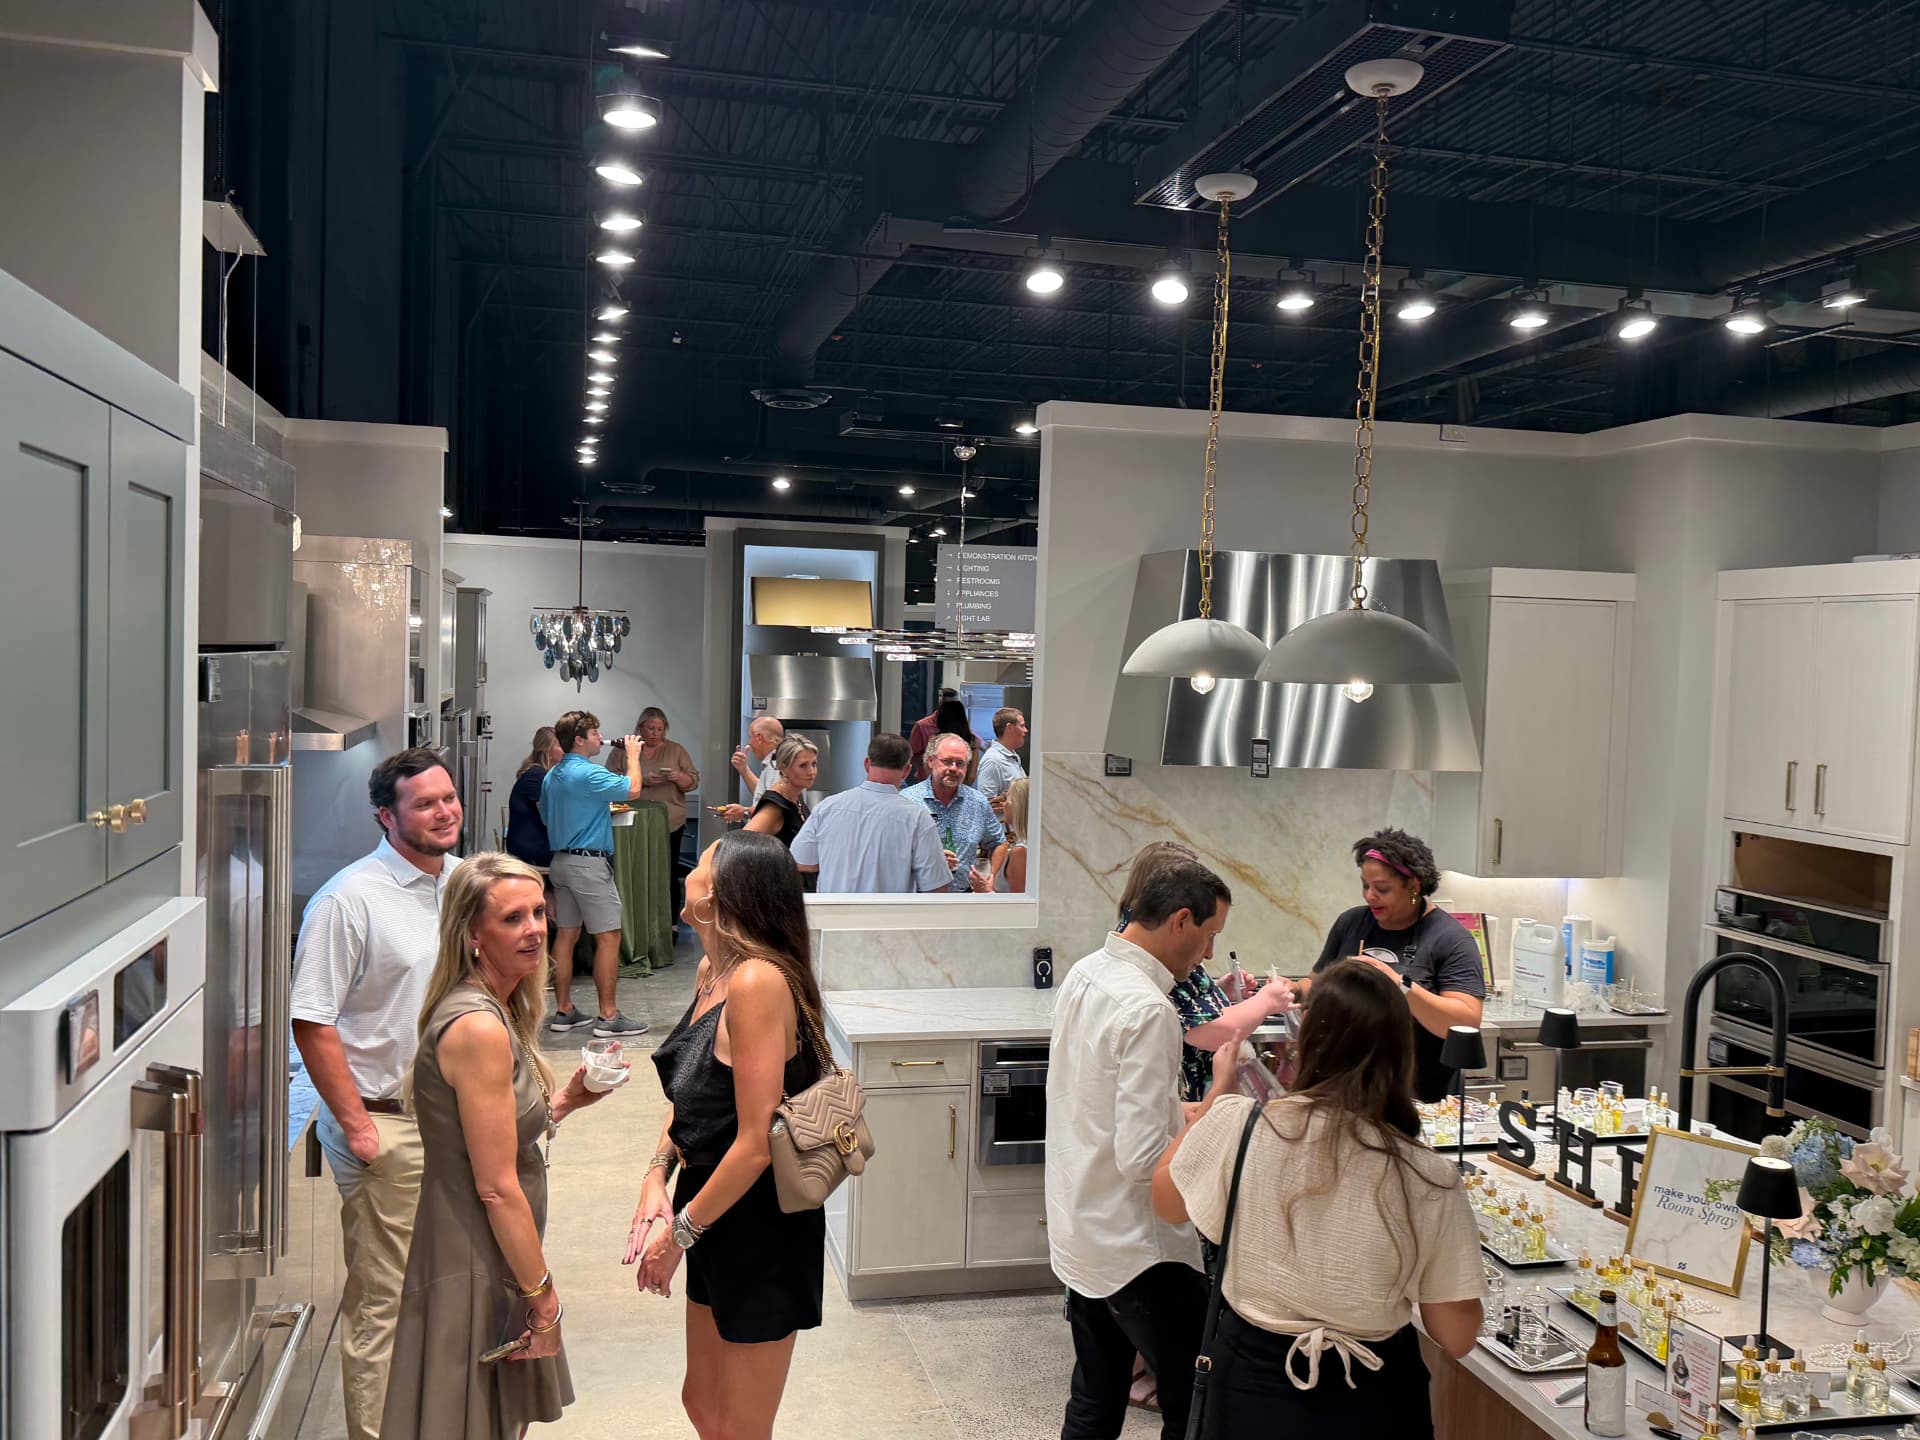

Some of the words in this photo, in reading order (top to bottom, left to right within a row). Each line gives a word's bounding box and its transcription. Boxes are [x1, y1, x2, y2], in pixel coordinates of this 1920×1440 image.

[1654, 1185, 1684, 1199] make
[1687, 1193, 1710, 1206] your
[1714, 1201, 1740, 1214] own
[1656, 1194, 1695, 1217] Room
[1698, 1206, 1738, 1231] Spray
